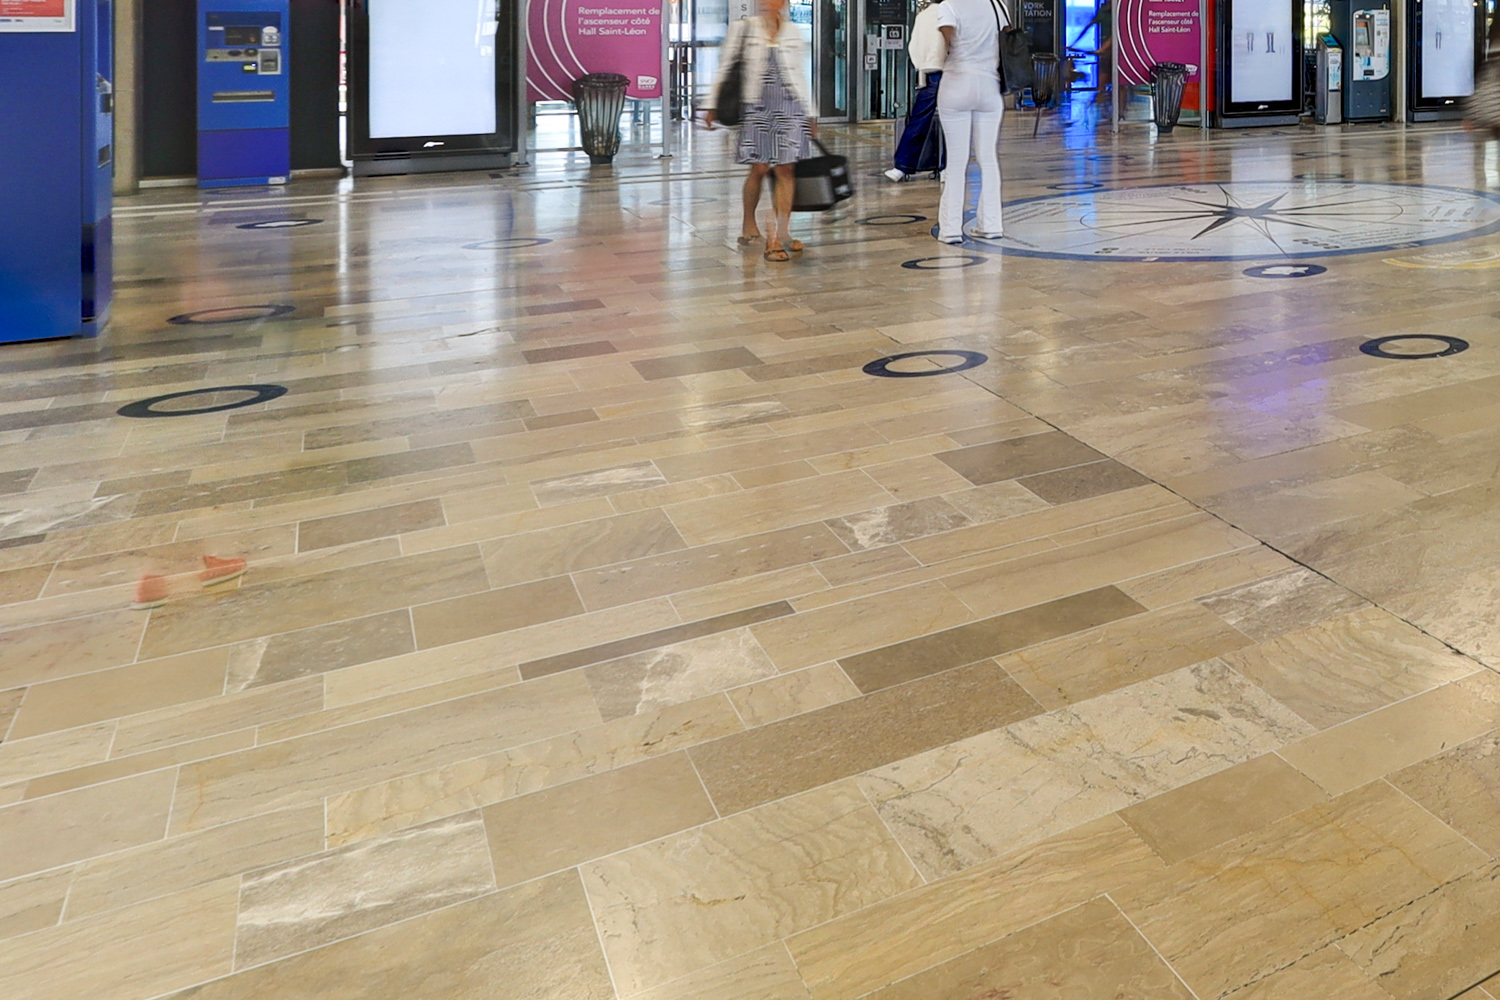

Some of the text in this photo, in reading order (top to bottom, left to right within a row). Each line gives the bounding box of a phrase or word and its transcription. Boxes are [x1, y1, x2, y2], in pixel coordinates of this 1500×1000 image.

[578, 7, 660, 18] Remplacement de
[1148, 10, 1190, 20] Remplacement
[578, 16, 651, 25] l'ascenseur côté
[578, 27, 647, 36] Hall Saint-Léon
[1161, 26, 1191, 34] Saint-Léon
